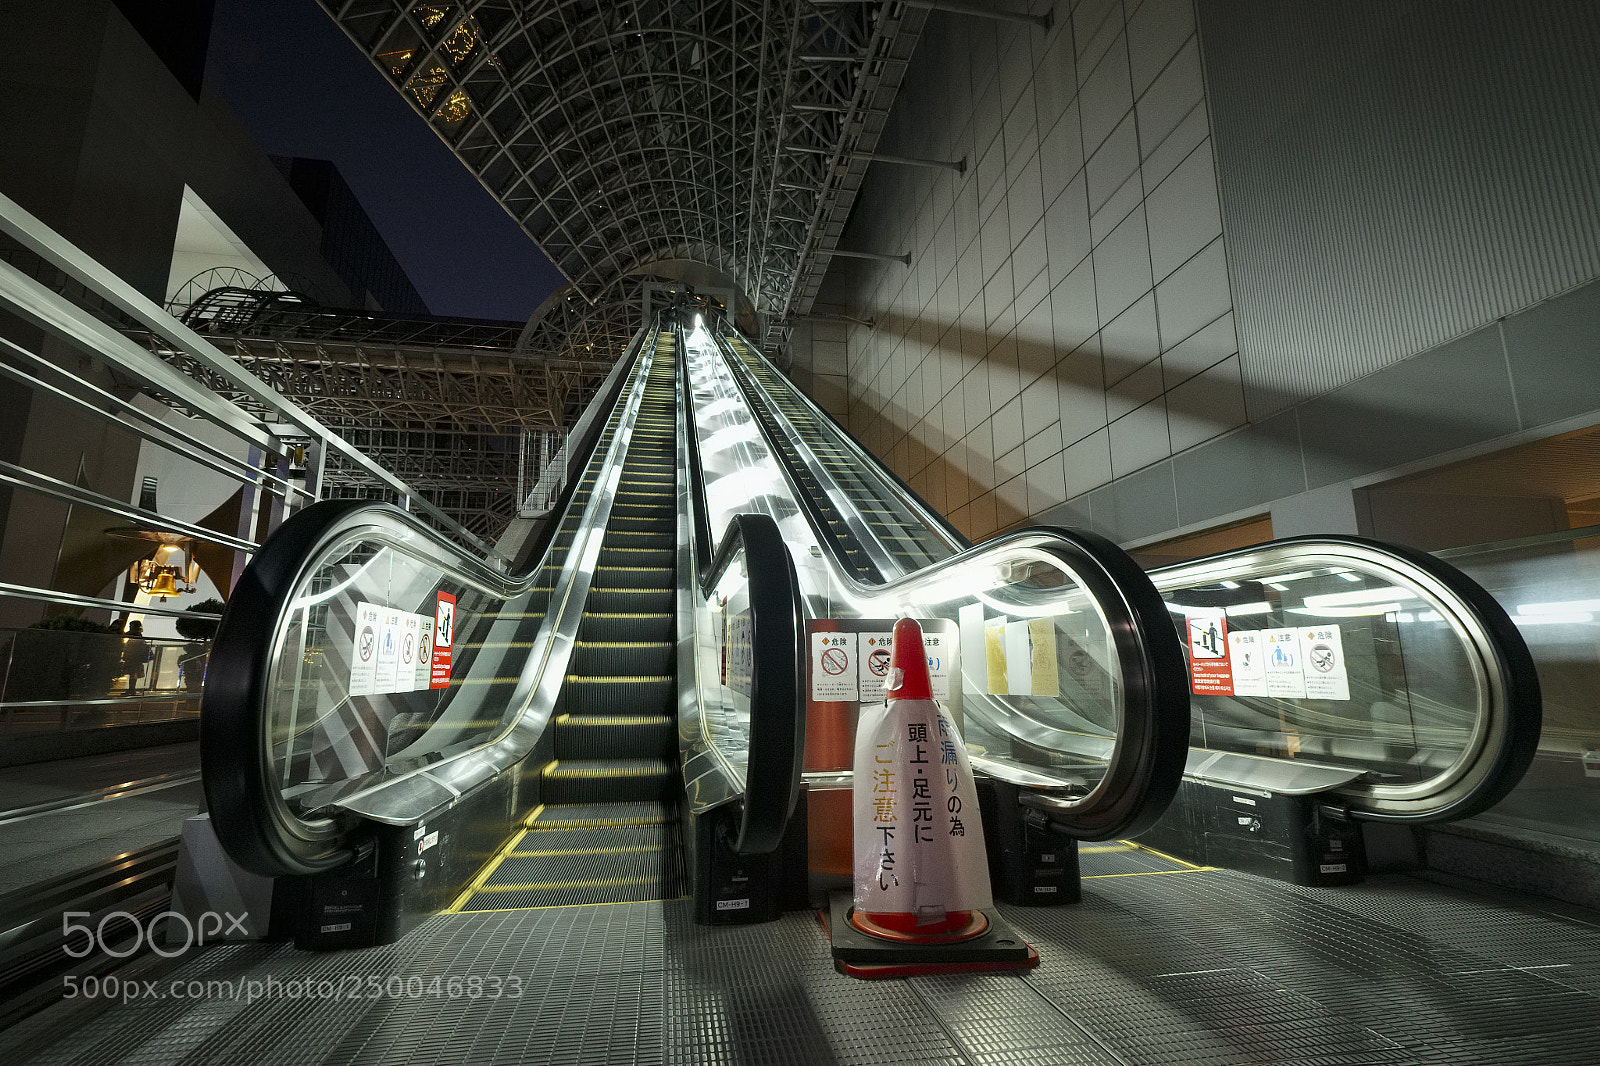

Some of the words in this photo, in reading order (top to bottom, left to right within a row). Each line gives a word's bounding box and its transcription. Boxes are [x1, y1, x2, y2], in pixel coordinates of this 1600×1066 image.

[831, 637, 848, 646] 危険
[924, 637, 940, 646] 注意
[936, 714, 965, 837] 雨漏りの為
[872, 740, 899, 892] ご注意下さい
